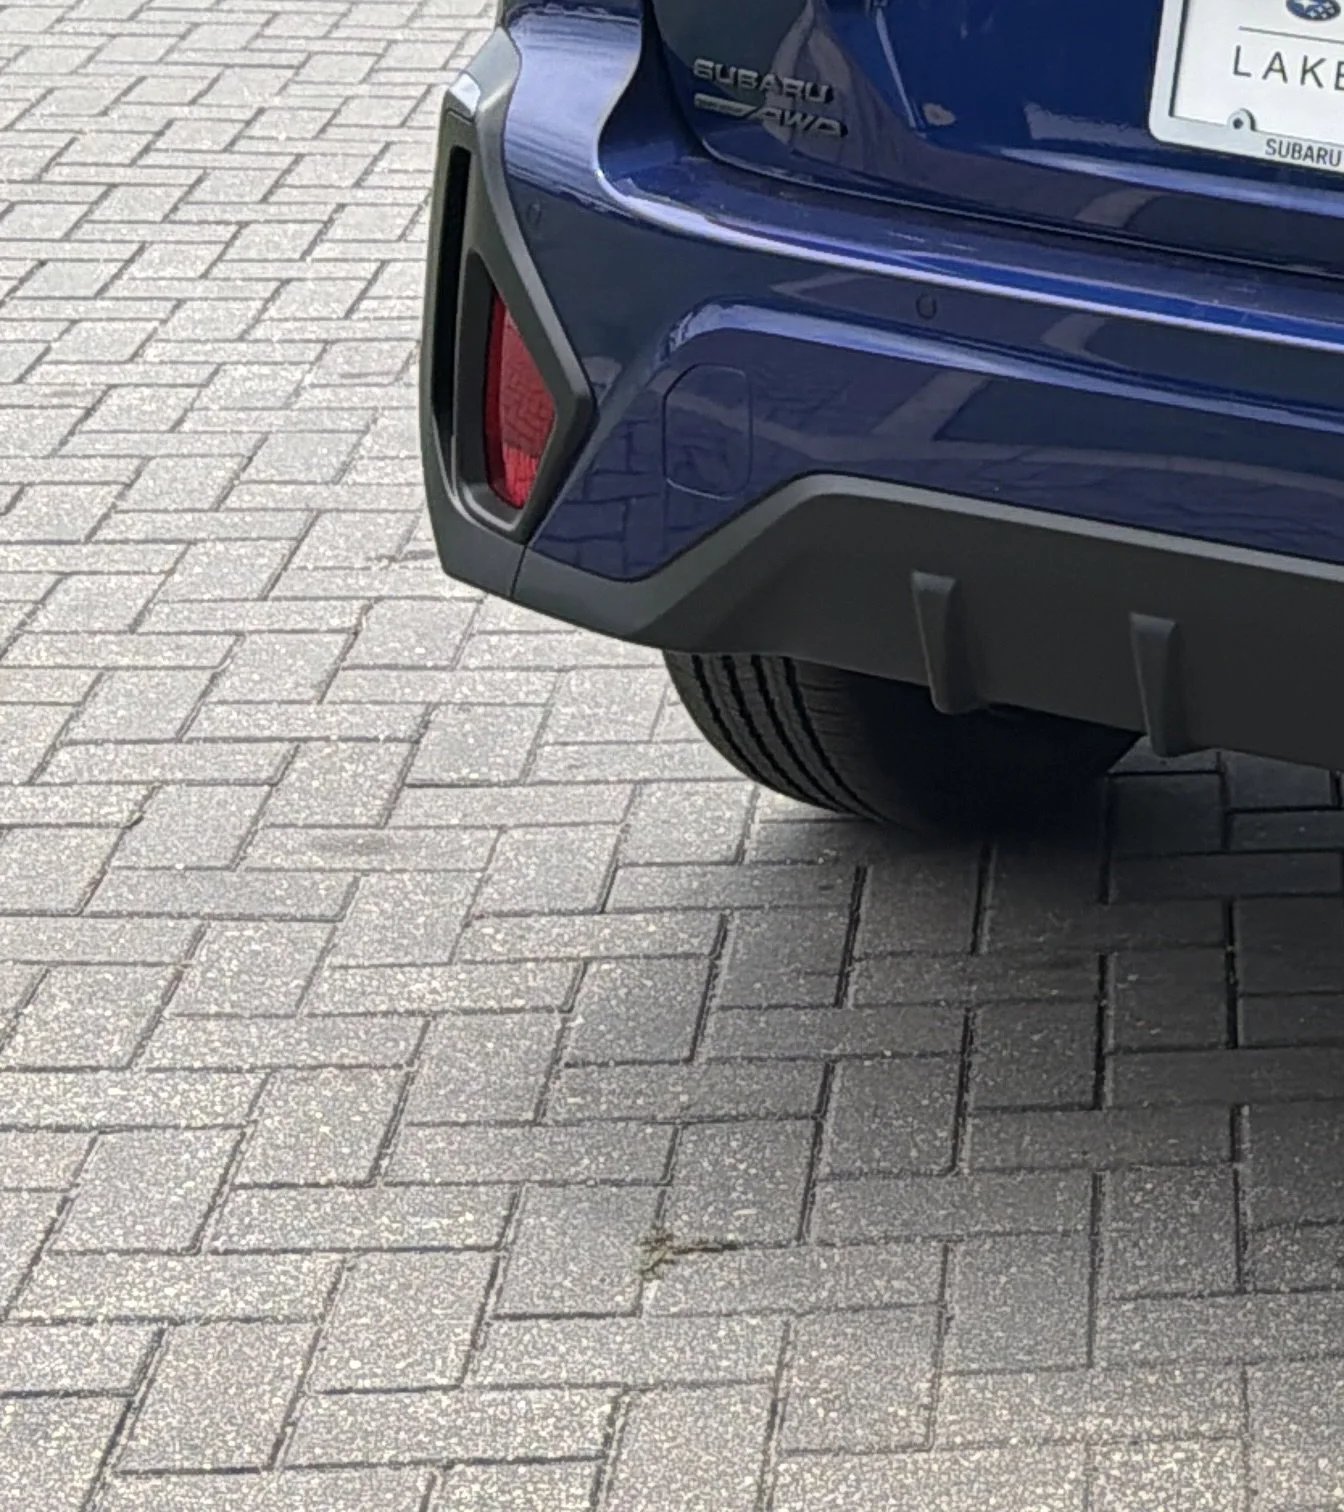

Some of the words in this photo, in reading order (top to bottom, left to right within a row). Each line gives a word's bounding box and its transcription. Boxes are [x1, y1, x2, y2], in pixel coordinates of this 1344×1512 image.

[693, 58, 830, 103] SUBARU
[749, 107, 843, 137] AWD
[1265, 138, 1342, 168] SUBARU
